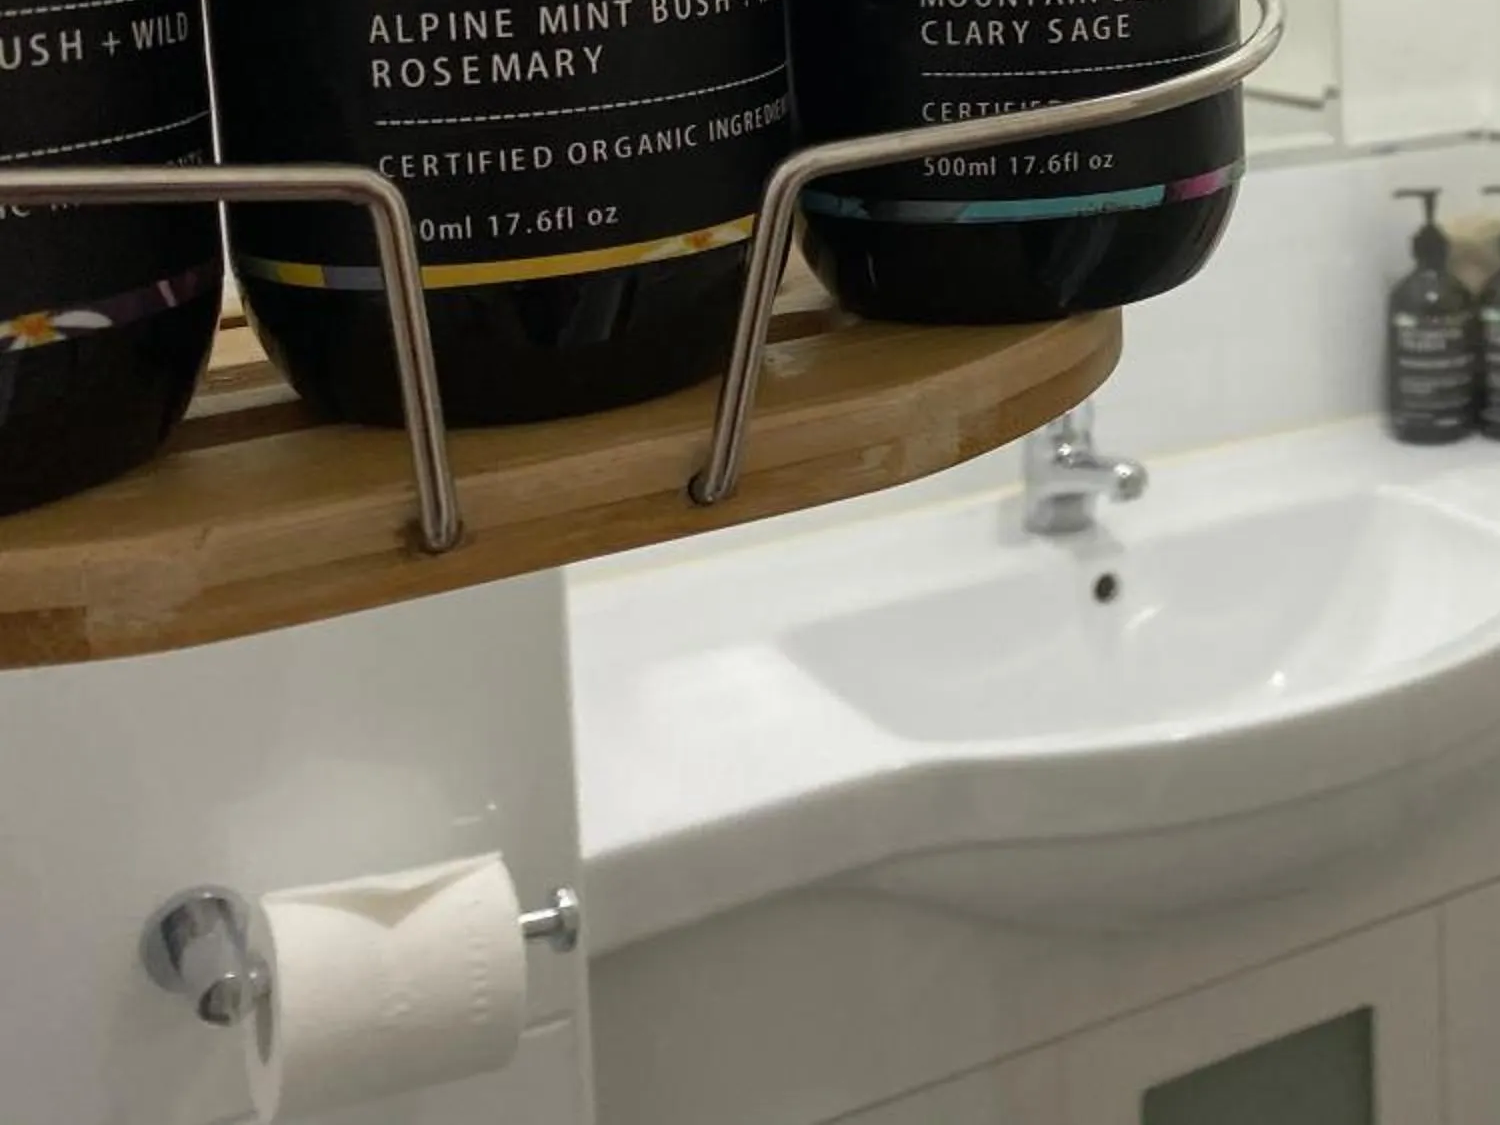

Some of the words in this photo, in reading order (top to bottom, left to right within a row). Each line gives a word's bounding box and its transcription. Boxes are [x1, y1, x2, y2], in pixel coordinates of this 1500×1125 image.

[131, 11, 189, 51] WILD
[369, 6, 514, 44] ALPINE
[921, 18, 1030, 47] CLARY
[1047, 13, 1131, 43] SAGE
[371, 45, 605, 90] ROSEMARY
[921, 99, 1066, 123] CERTI
[379, 145, 553, 179] CERTIFIED
[567, 123, 698, 165] ORGANIC
[923, 156, 997, 177] 500ml
[1008, 150, 1079, 175] 17.6fl
[1088, 153, 1114, 171] oz
[418, 215, 473, 243] 0ml
[487, 205, 574, 239] 17.6fl
[586, 205, 619, 227] oz
